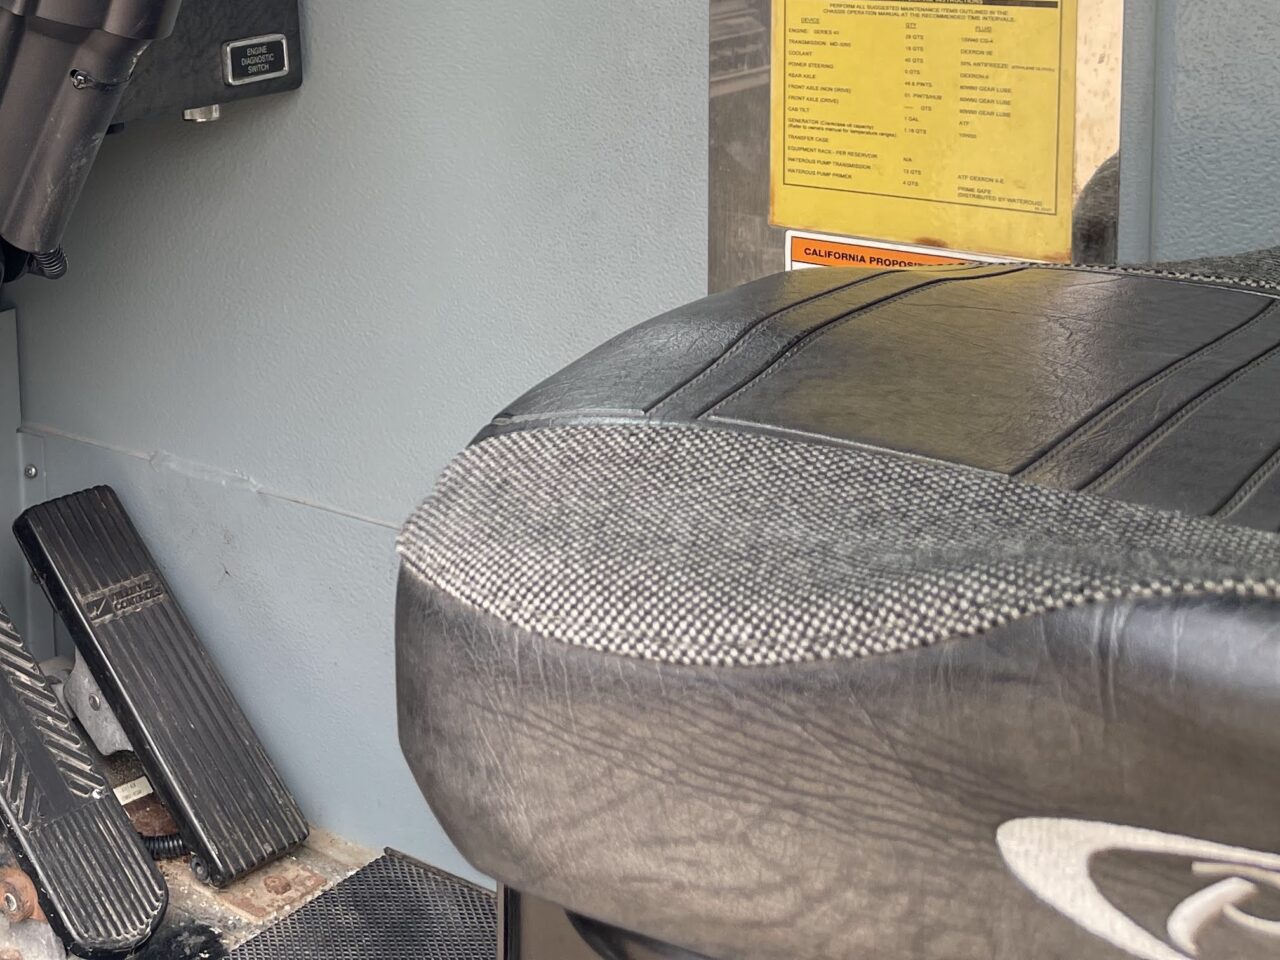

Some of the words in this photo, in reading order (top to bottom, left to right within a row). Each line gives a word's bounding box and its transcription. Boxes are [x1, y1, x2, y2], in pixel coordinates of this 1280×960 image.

[247, 46, 267, 56] ENGINE
[241, 53, 274, 65] DIAGNOSTIC
[248, 64, 269, 73] SWITCH
[804, 247, 866, 263] CALIFORNIA
